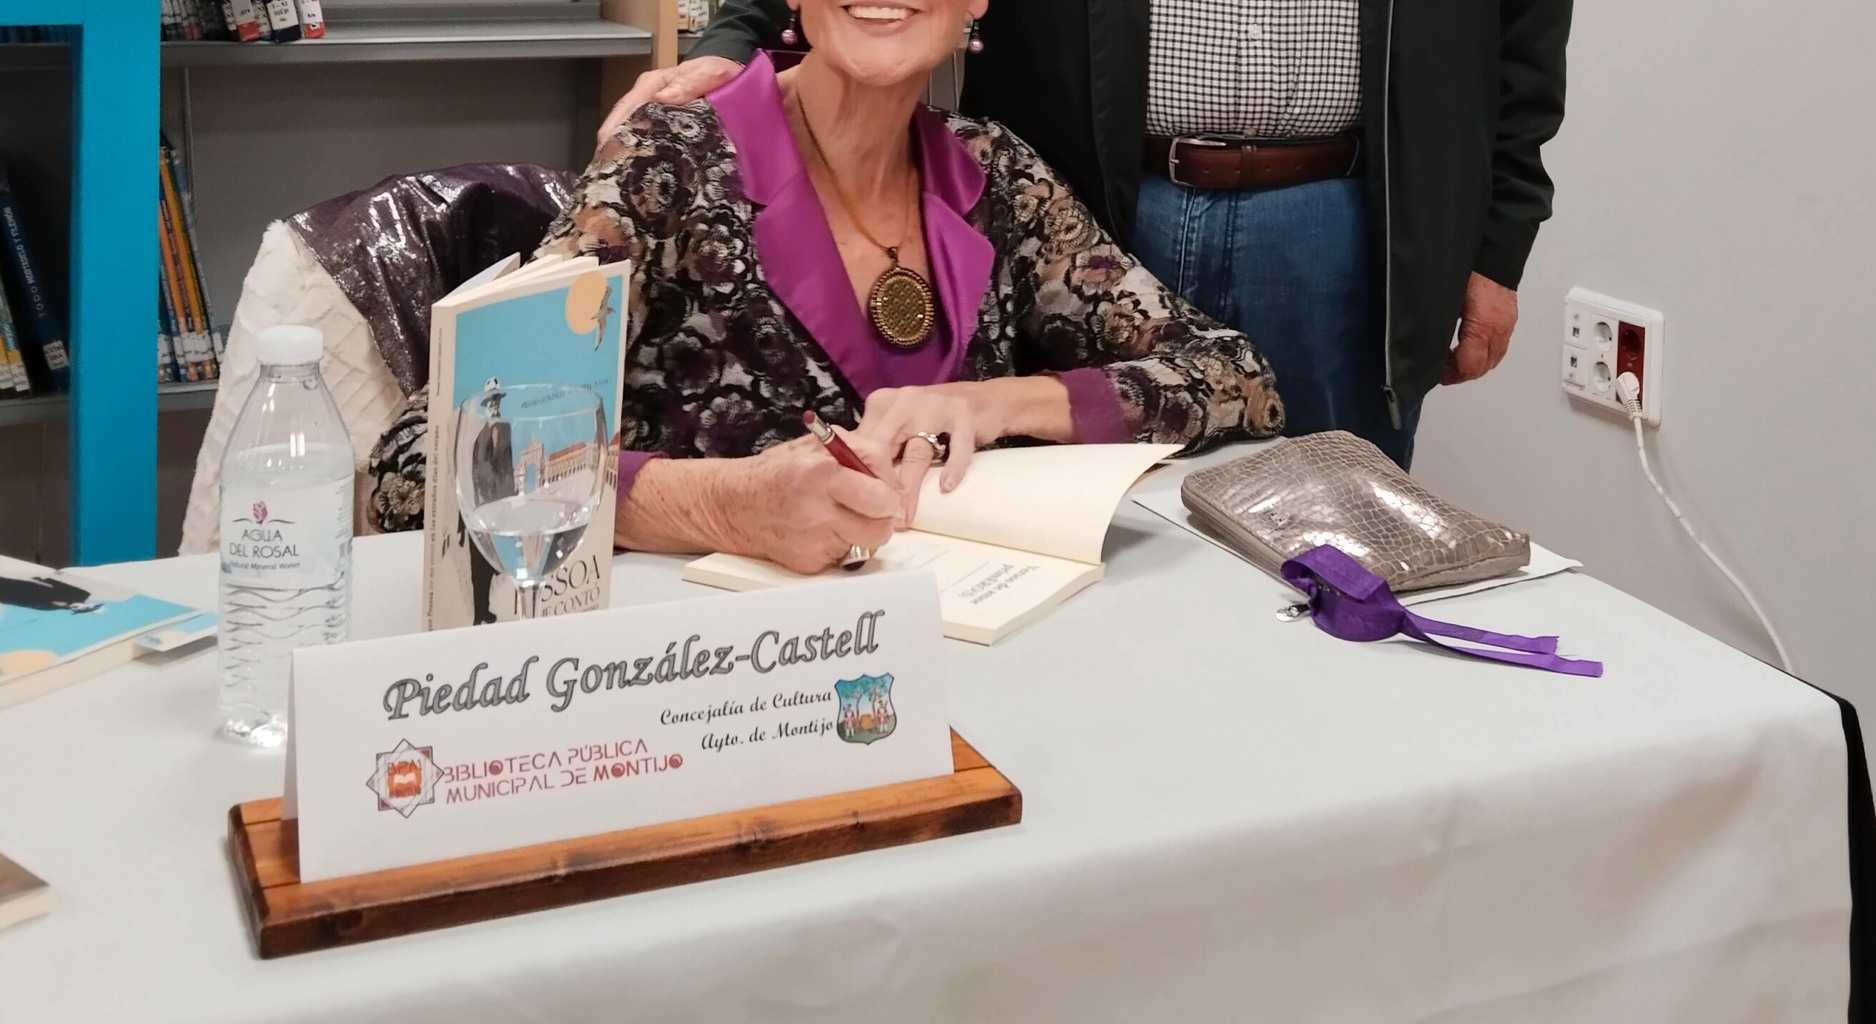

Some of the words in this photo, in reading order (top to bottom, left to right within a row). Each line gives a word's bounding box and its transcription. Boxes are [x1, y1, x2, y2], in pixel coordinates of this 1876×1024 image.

[229, 542, 249, 558] DEL
[252, 544, 300, 559] ROSAL
[241, 529, 283, 542] AGUA
[251, 562, 278, 571] Mineral
[279, 562, 301, 570] Water
[383, 654, 540, 721] Piedad
[545, 610, 886, 713] González-Castell
[660, 701, 744, 726] Concejalía
[749, 696, 767, 713] de
[772, 689, 833, 710] Cultura
[701, 730, 744, 753] Ayto.
[749, 727, 767, 742] de
[771, 720, 834, 740] Montijo
[443, 751, 562, 784] BIBLIOTECA
[567, 738, 649, 764] PÚBLICA
[446, 777, 555, 805] MUNICIPAL
[560, 768, 588, 786] DE
[593, 753, 684, 782] MONTIJO
